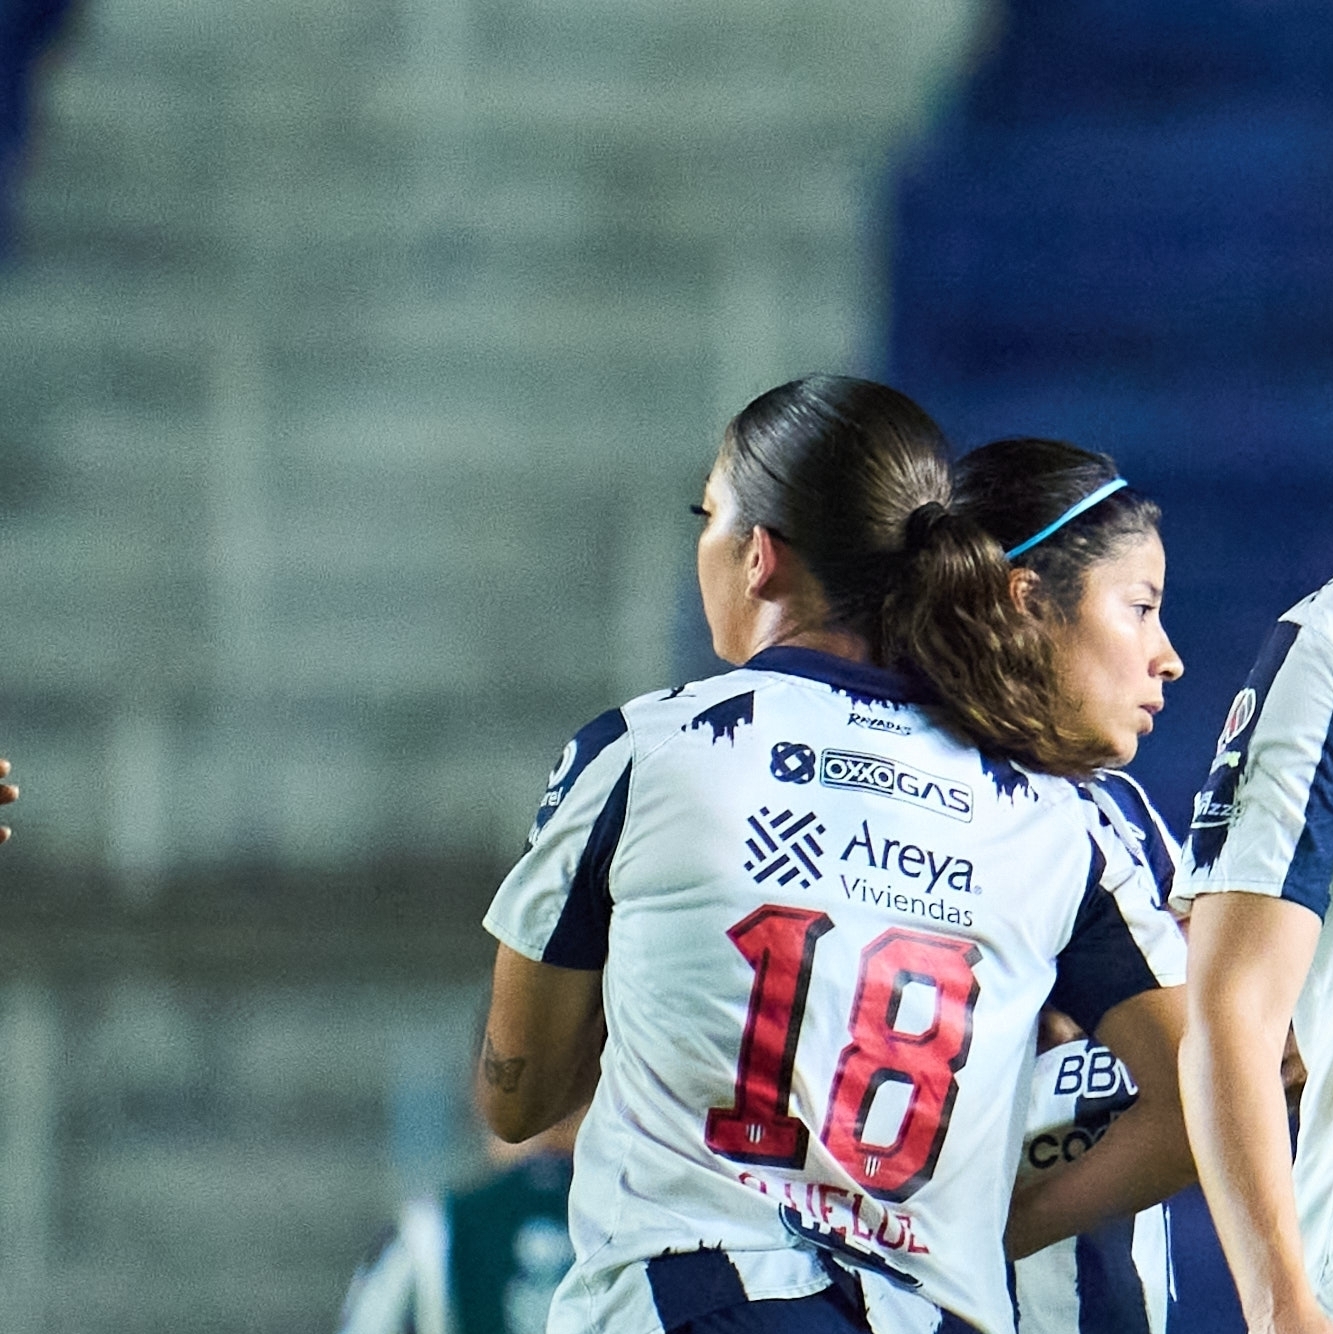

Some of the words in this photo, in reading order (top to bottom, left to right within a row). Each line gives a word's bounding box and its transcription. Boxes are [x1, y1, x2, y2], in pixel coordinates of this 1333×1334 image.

[839, 818, 975, 894] Areya
[840, 874, 974, 928] Viviendas
[705, 904, 981, 1203] 18
